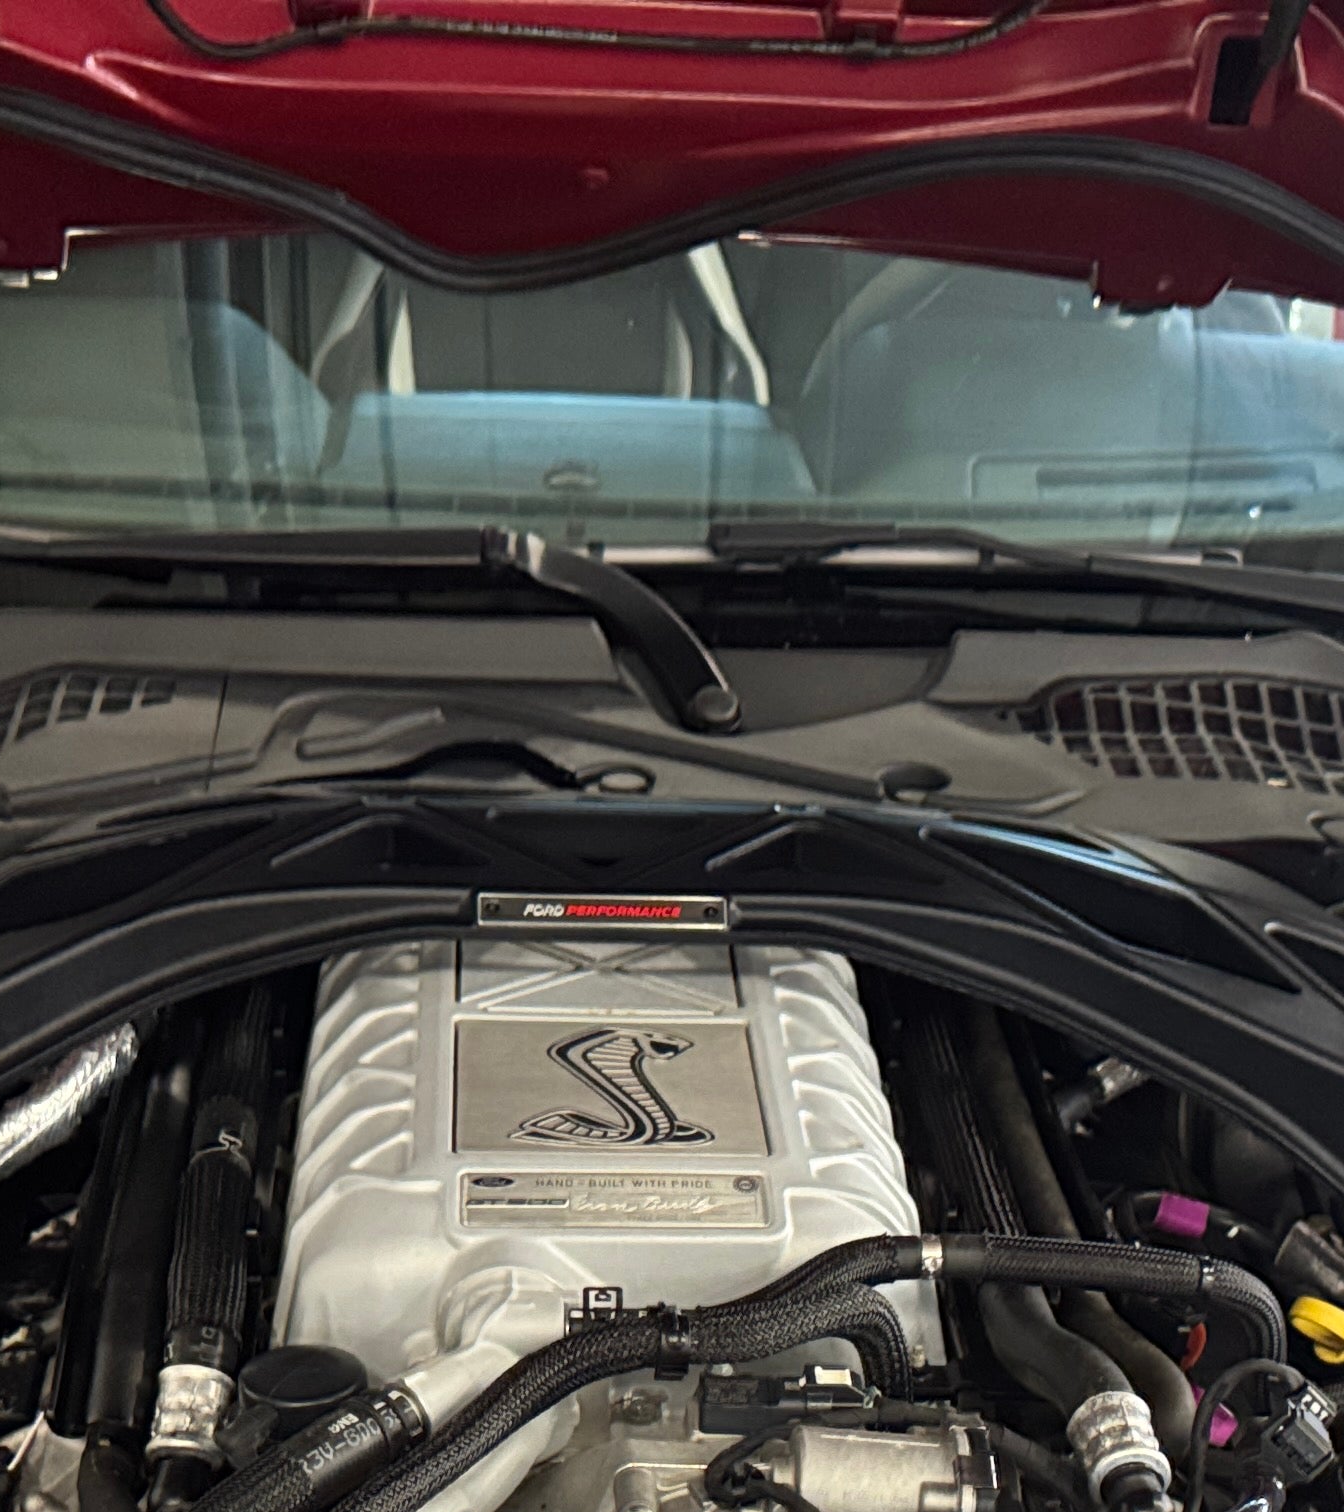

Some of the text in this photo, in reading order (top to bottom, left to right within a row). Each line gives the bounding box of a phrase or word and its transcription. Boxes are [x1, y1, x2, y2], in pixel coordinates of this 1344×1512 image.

[523, 903, 682, 919] FORD PERFORMANCE
[535, 1178, 574, 1188] HAND
[588, 1179, 625, 1188] BUILT
[632, 1179, 667, 1188] WITH
[672, 1179, 713, 1189] PRIDE
